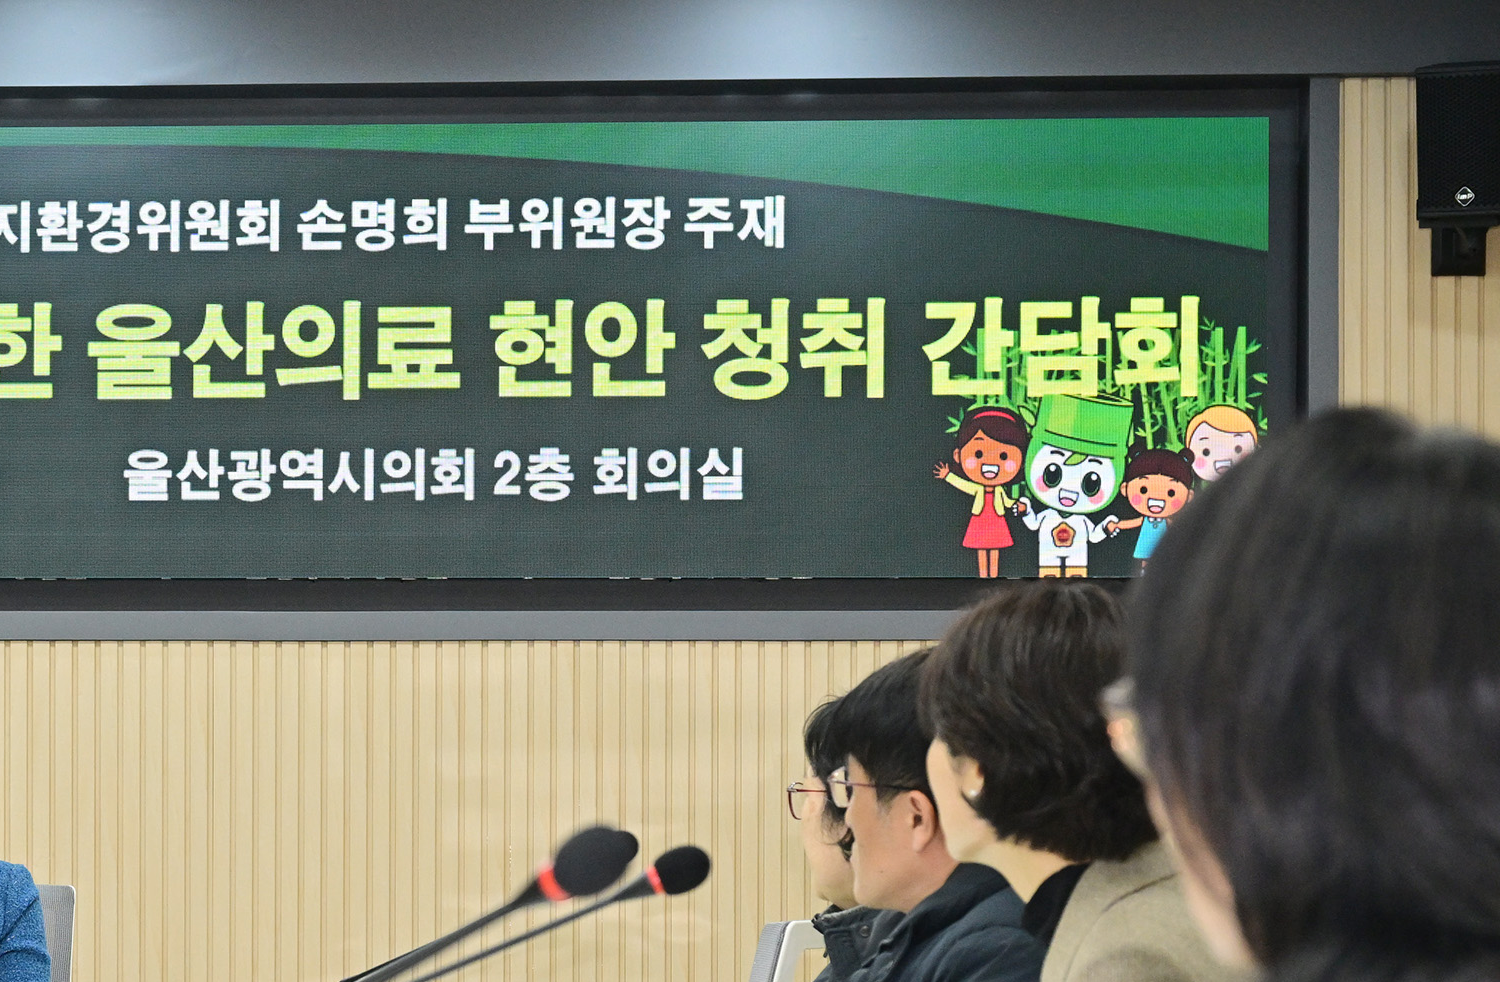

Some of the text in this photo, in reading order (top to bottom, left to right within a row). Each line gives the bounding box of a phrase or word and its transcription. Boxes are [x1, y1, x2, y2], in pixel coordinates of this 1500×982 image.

[297, 198, 447, 251] 손명희
[465, 196, 670, 250] 부위원장
[684, 195, 785, 249] 주재
[88, 301, 460, 400] 울산의료
[490, 299, 675, 397] 현안
[701, 297, 885, 400] 청취
[921, 296, 1201, 398] 간담회
[124, 447, 742, 502] 울산광역시의회 2층 회의실
